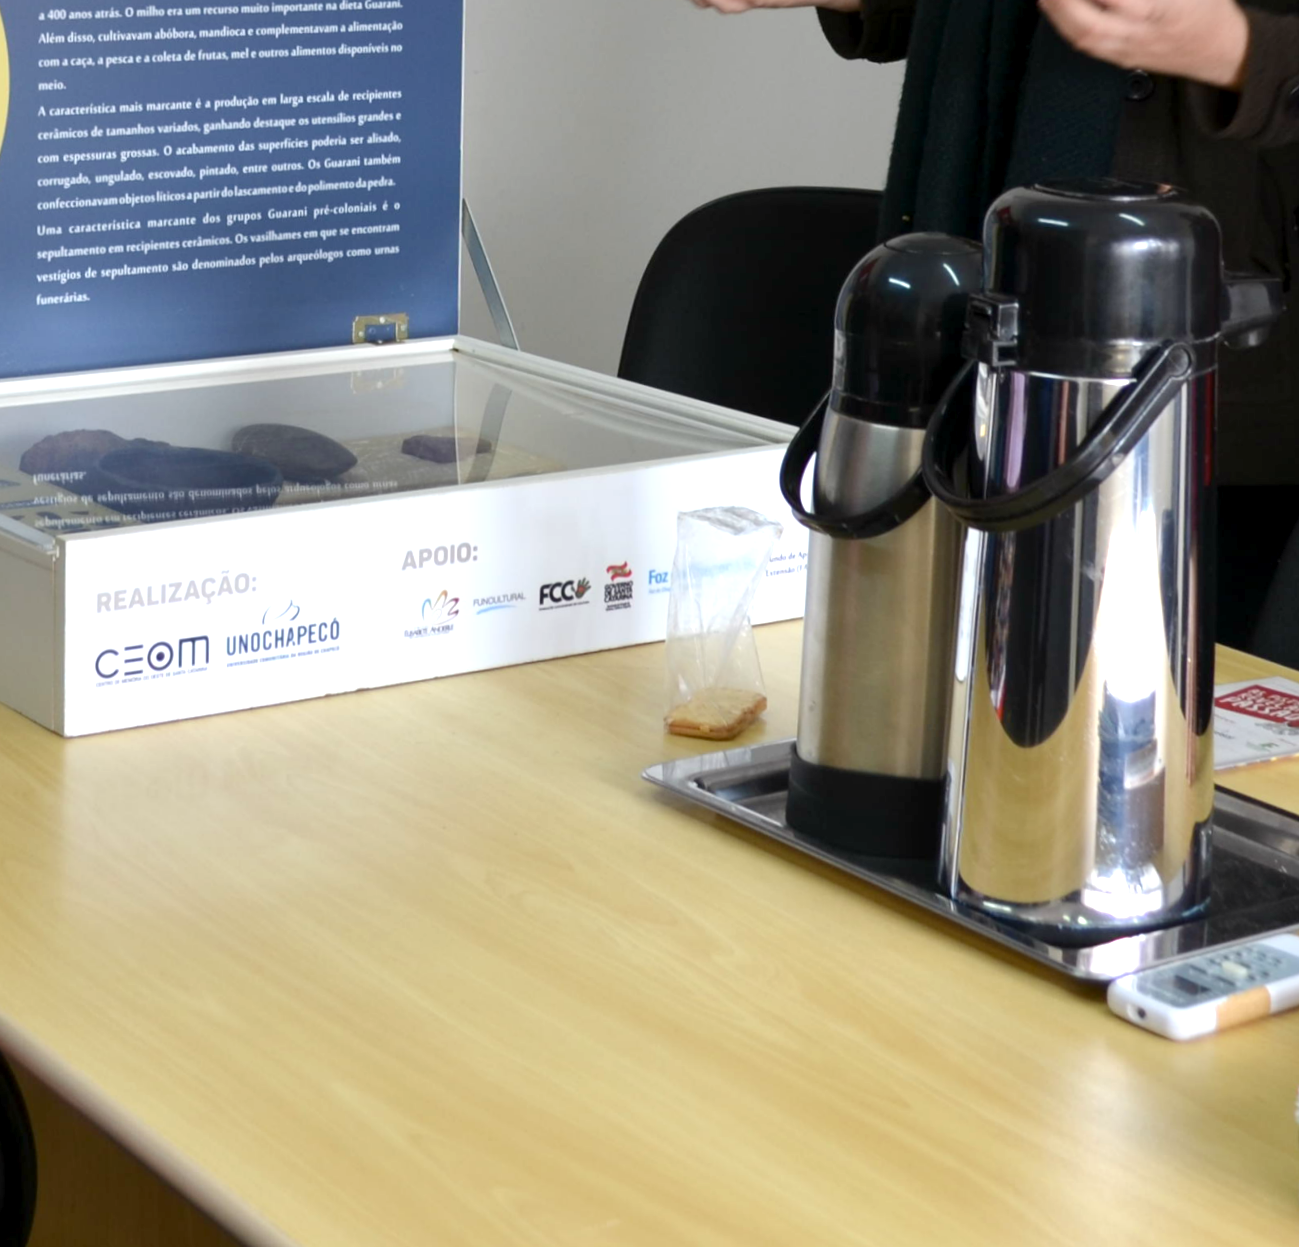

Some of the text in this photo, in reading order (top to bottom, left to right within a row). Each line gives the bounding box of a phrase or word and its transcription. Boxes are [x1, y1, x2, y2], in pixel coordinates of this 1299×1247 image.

[38, 12, 45, 20] a
[47, 9, 66, 20] 400
[68, 10, 92, 19] anos
[94, 7, 122, 18] atrás.
[124, 6, 134, 17] O
[136, 5, 165, 17] milho
[166, 8, 183, 16] era
[184, 7, 201, 15] um
[203, 6, 239, 15] recurso
[240, 2, 269, 13] muito
[271, 1, 323, 16] importante
[325, 2, 337, 10] na
[38, 19, 403, 44] Além disso, cultivavam abóbora, mandioca e complementavam a alimentação
[38, 41, 402, 68] com a caça, a pesca e a coleta de frutas, mel e outros alimentos disponíveis no
[38, 78, 66, 91] meio.
[38, 88, 402, 116] A característica mais marcante é a produção em larga escala de recipientes
[36, 290, 90, 305] funerárias.
[402, 542, 478, 570] APOIO:
[648, 569, 669, 585] Foz
[96, 570, 257, 613] REALIZAÇÃO:
[539, 580, 574, 605] FCC
[226, 617, 340, 656] UNOCHAPECÓ
[95, 635, 209, 679] CEOM
